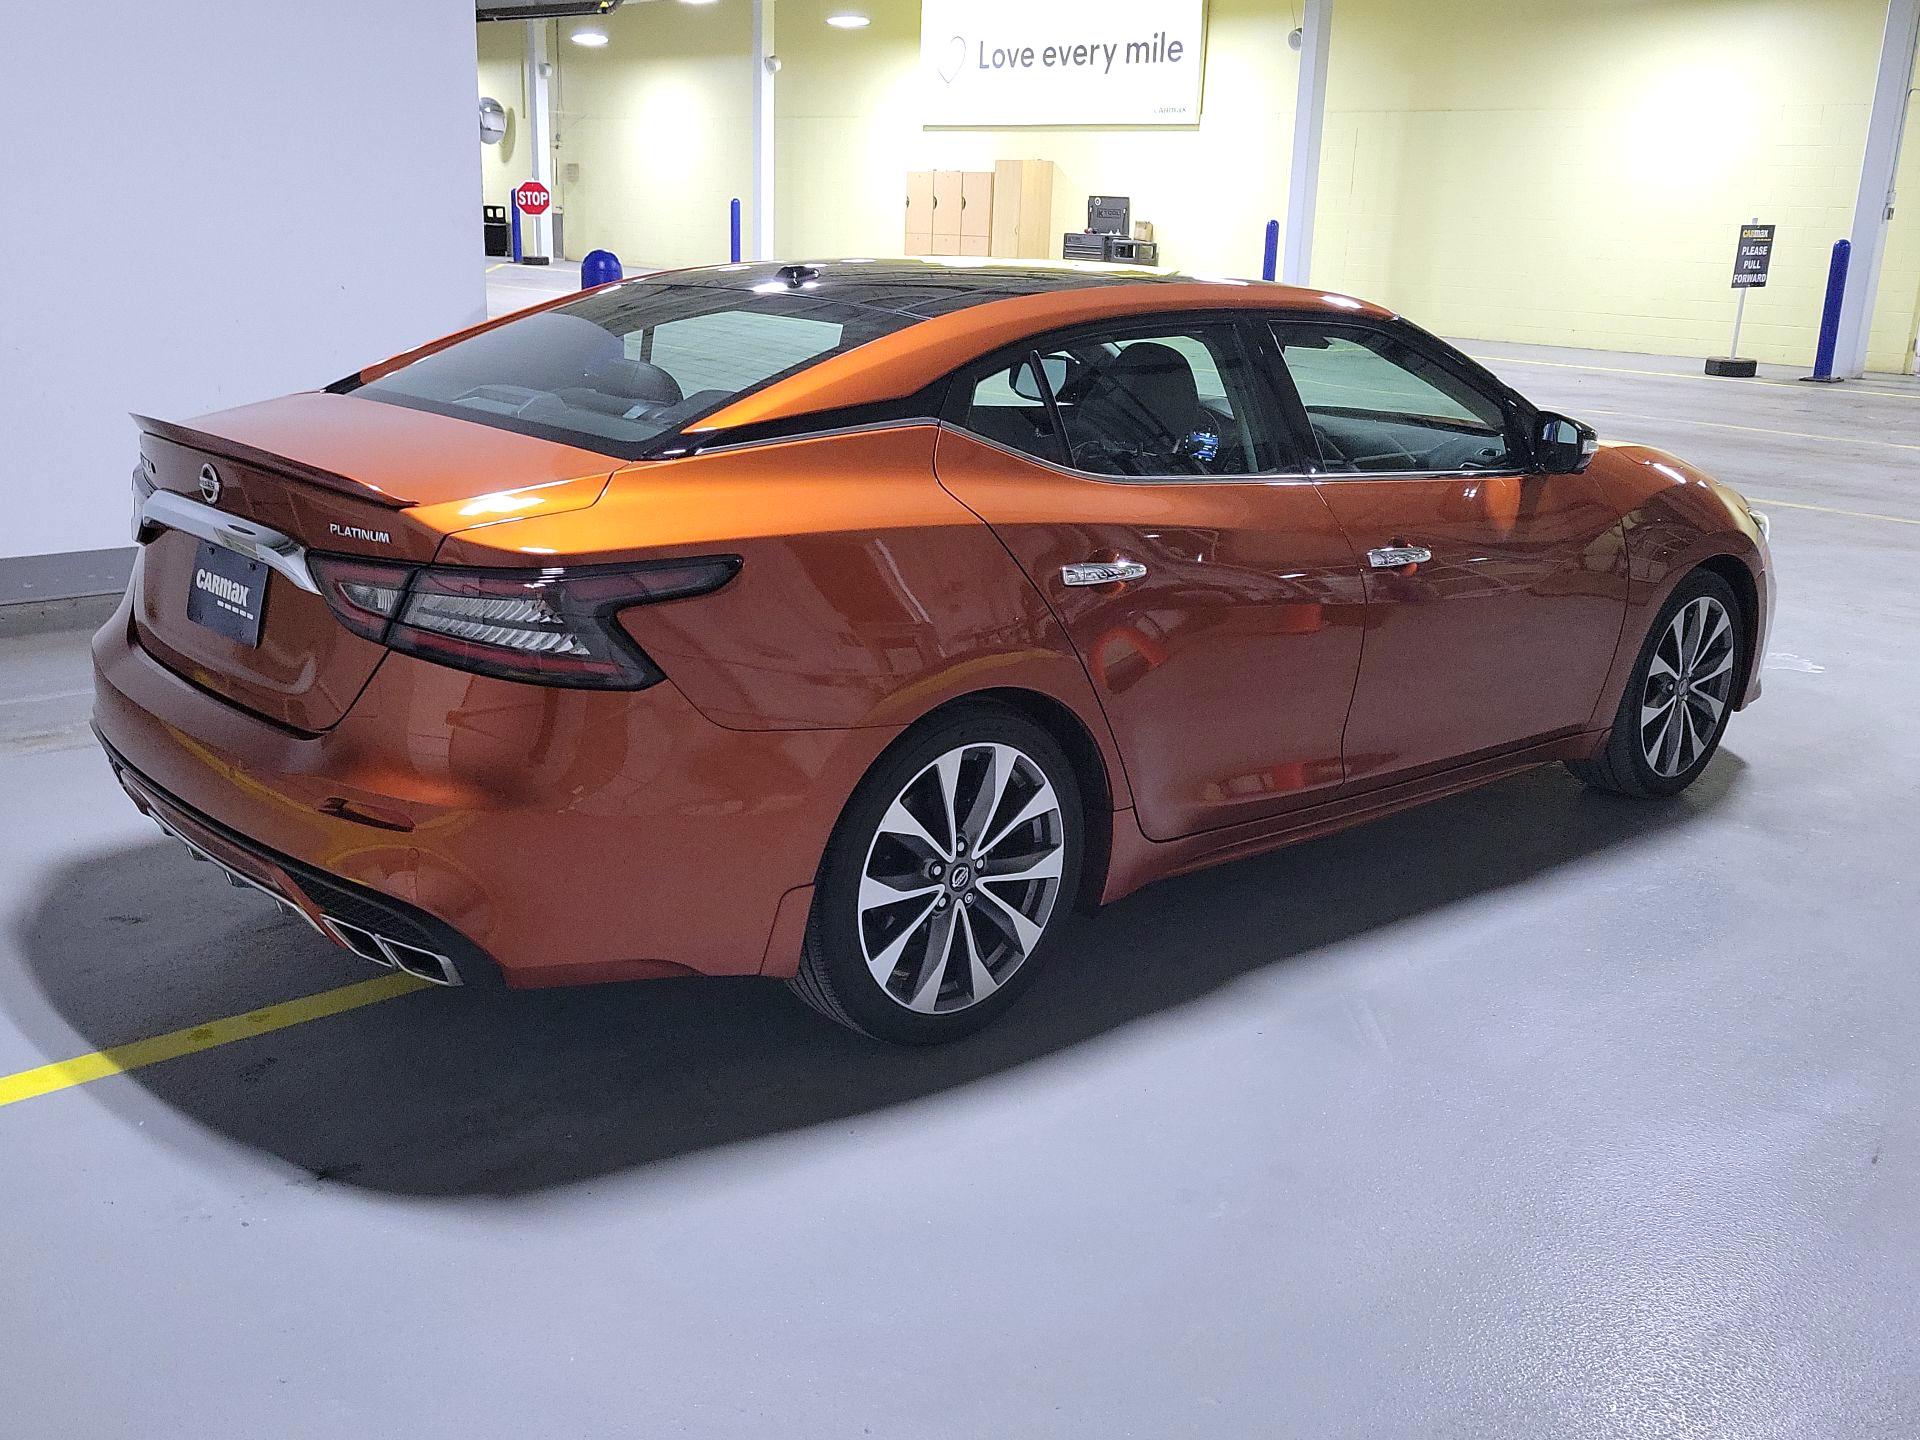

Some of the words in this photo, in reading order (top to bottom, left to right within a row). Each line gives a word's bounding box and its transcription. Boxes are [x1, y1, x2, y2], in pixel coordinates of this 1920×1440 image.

[979, 41, 1034, 69] Love
[1042, 44, 1117, 74] every
[1125, 32, 1184, 64] mile
[518, 191, 548, 206] STOP
[1741, 246, 1768, 255] PLEASE
[1743, 260, 1761, 269] PULL
[1733, 273, 1766, 283] FORWARD
[329, 523, 391, 544] PLATINUM
